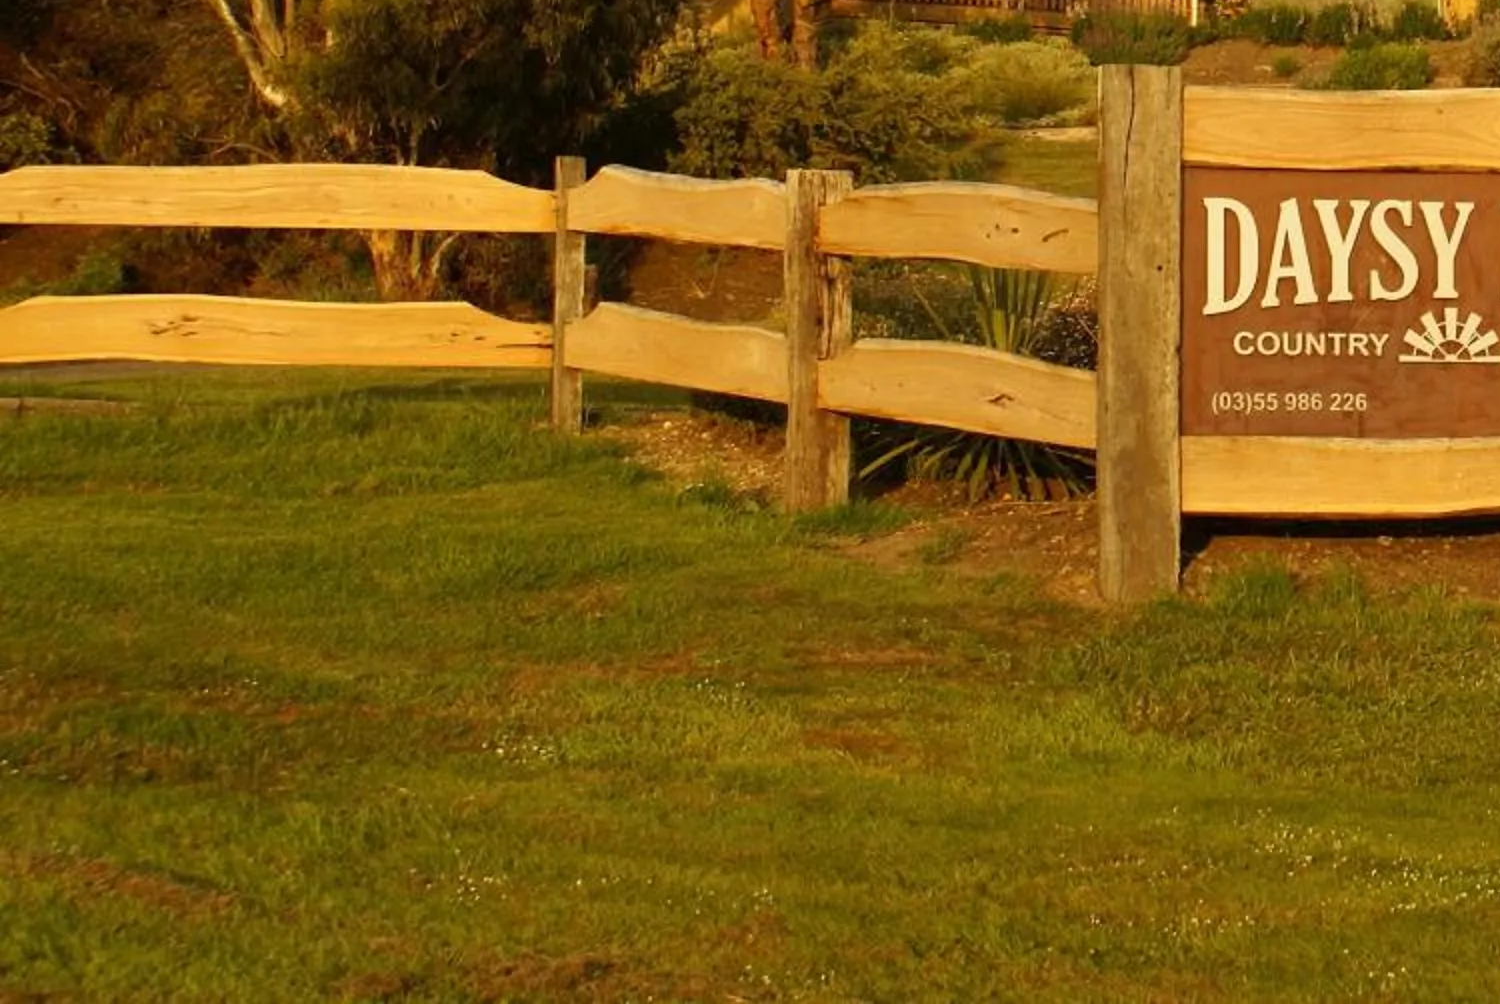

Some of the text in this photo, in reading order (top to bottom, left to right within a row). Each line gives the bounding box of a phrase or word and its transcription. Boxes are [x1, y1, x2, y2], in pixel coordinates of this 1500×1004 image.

[1202, 196, 1475, 316] DAYSY
[1233, 331, 1390, 357] COUNTRY
[1211, 391, 1368, 416] (03)55 986 226
